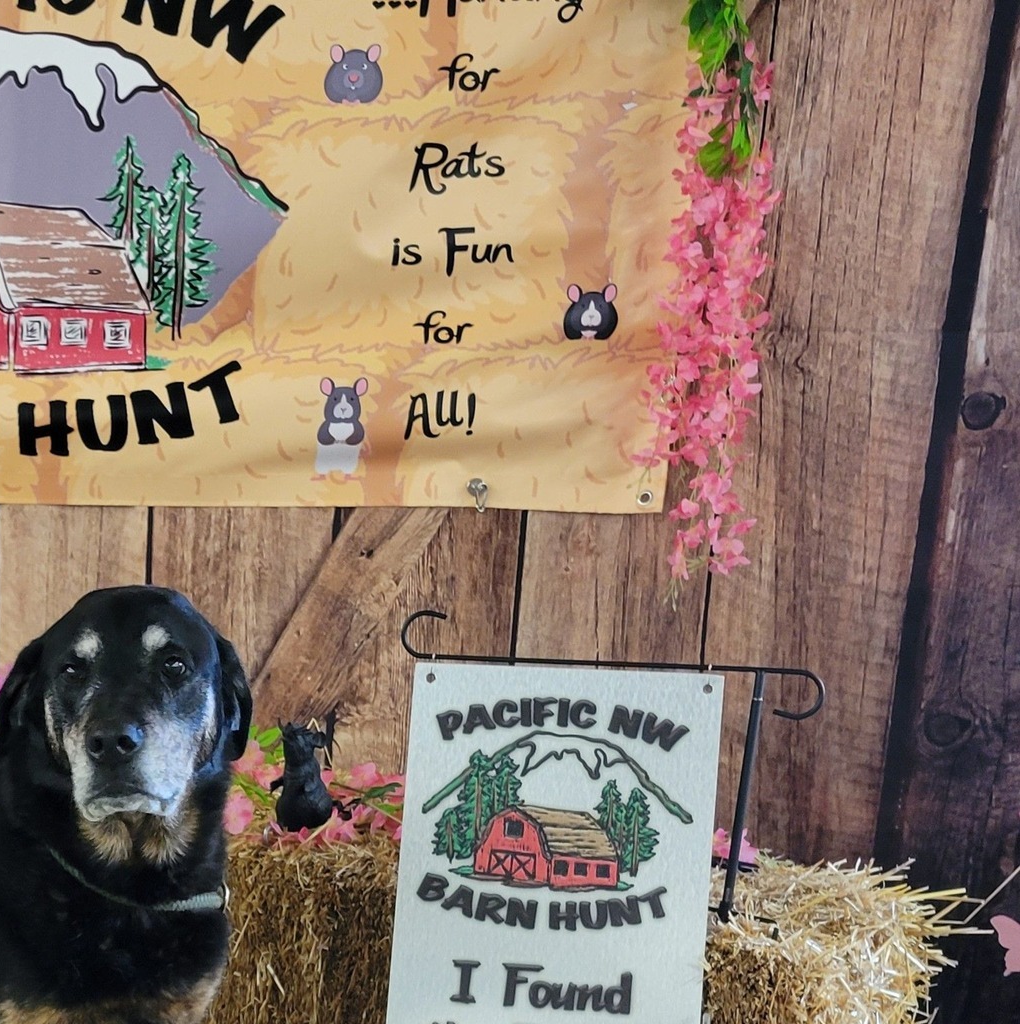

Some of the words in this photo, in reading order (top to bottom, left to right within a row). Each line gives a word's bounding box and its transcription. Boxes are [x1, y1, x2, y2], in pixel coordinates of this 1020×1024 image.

[121, 0, 285, 64] NW
[438, 53, 501, 92] for
[409, 141, 506, 195] Rats
[391, 238, 422, 267] is
[438, 227, 514, 277] Fun
[414, 310, 474, 344] for
[17, 360, 242, 457] HUNT
[404, 391, 476, 440] All!
[436, 697, 597, 740] PACIFIC
[608, 704, 690, 752] NW
[416, 873, 538, 930] BARN
[548, 886, 667, 931] HUNT
[450, 959, 481, 1004] I
[502, 962, 633, 1015] Found
